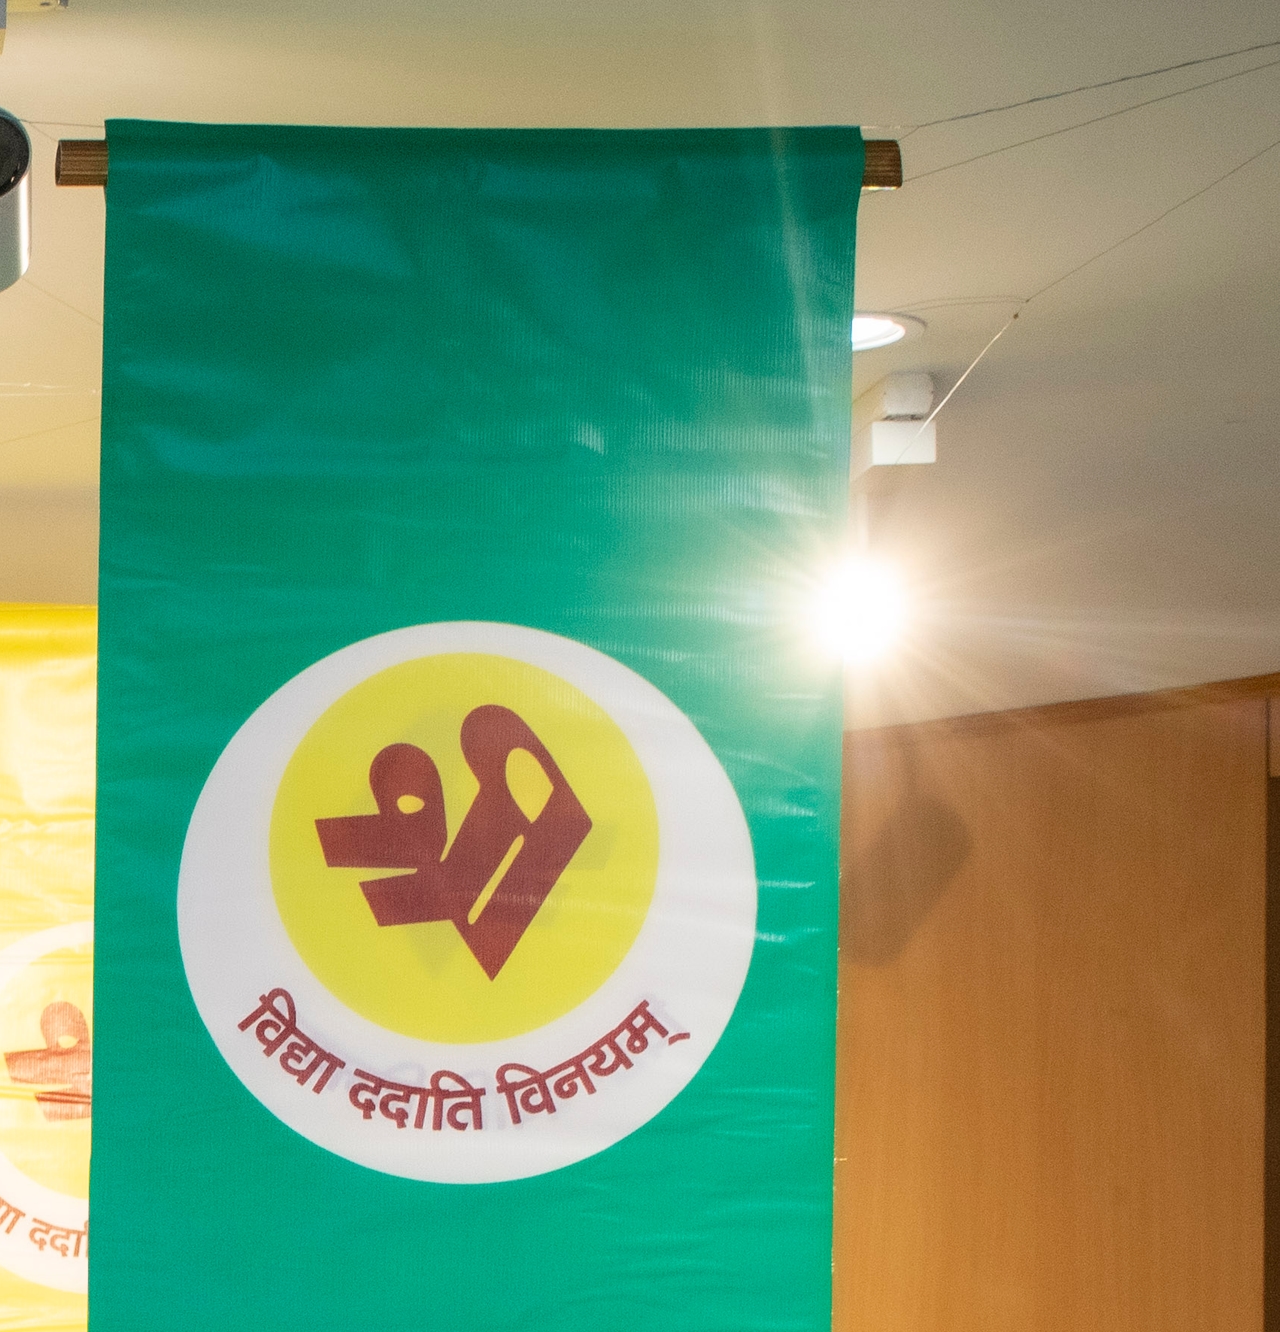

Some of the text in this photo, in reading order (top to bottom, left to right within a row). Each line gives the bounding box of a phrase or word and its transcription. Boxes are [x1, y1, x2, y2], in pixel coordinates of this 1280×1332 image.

[238, 988, 690, 1130] विद्या ददाति विनयम्
